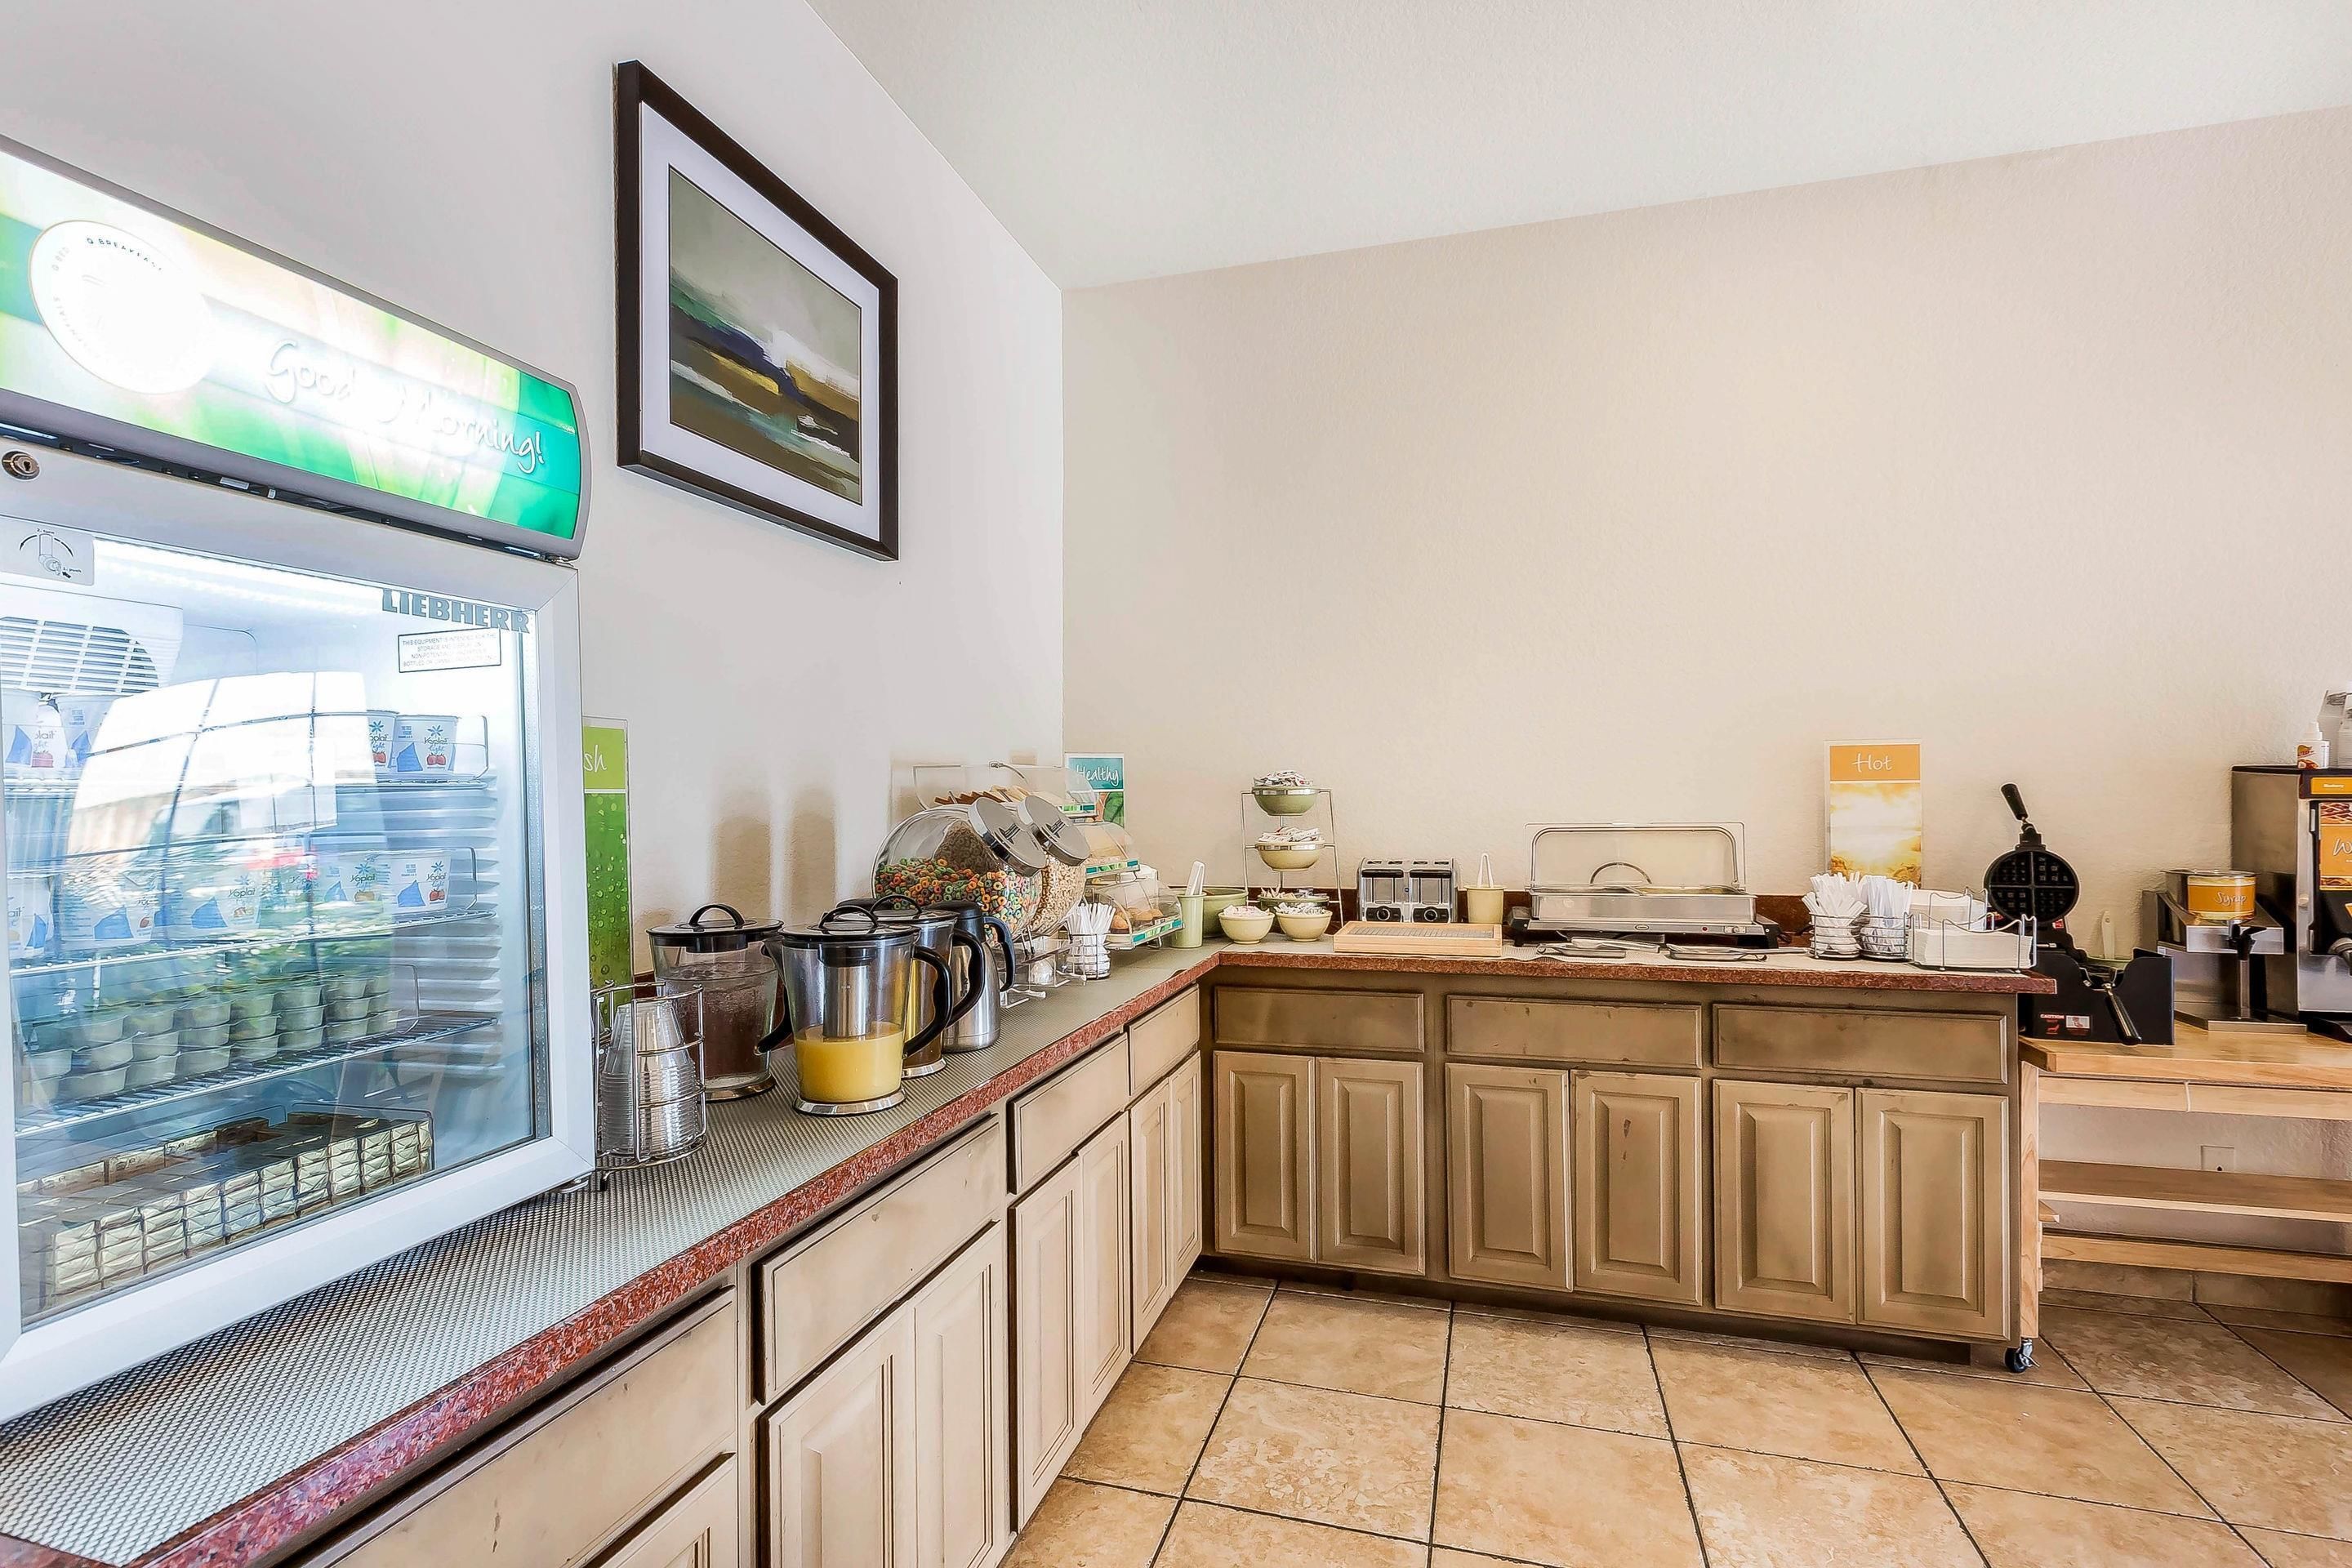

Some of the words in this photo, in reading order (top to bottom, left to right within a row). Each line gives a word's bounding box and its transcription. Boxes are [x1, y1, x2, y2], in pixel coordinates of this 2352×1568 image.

[98, 238, 163, 272] BREAKFA
[265, 340, 355, 404] Good
[382, 587, 530, 634] LIEBHERR
[1076, 764, 1119, 786] Healthy
[1851, 753, 1893, 773] Hot
[2214, 892, 2247, 906] Syrup
